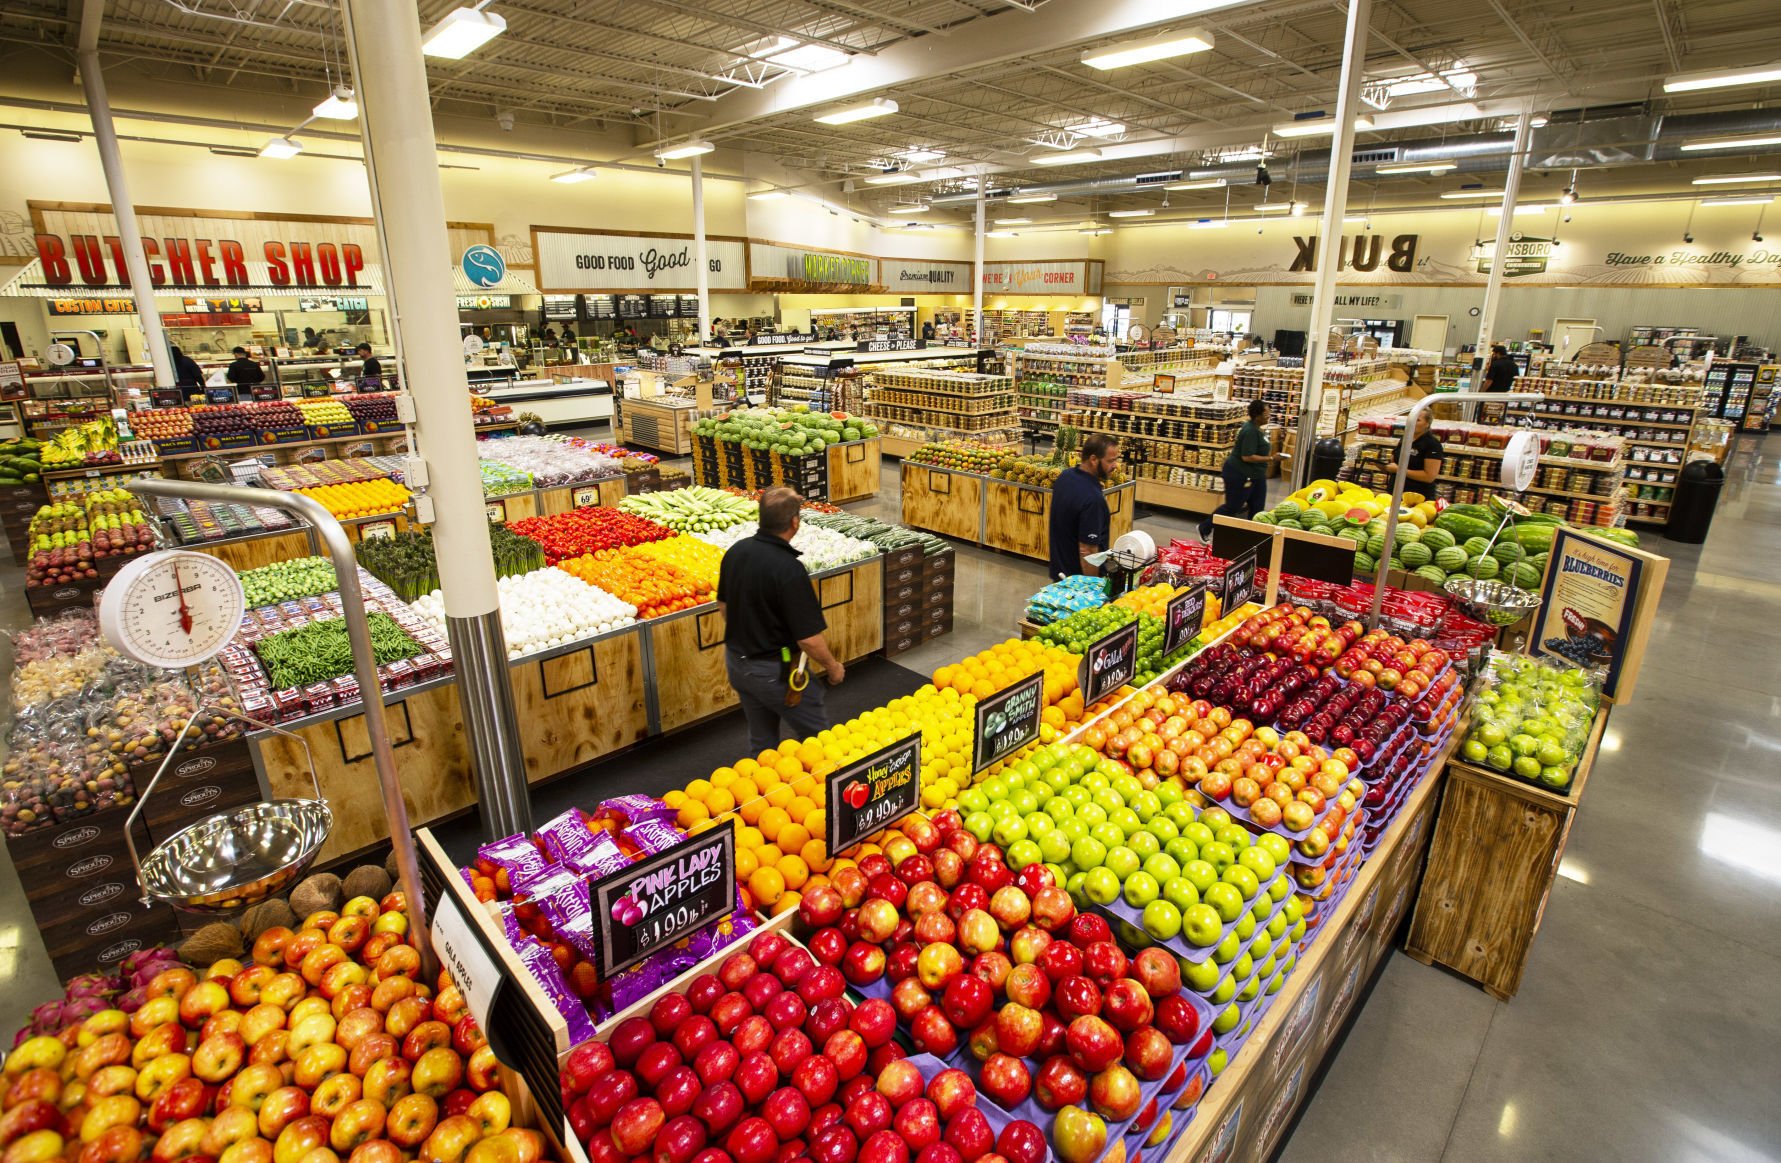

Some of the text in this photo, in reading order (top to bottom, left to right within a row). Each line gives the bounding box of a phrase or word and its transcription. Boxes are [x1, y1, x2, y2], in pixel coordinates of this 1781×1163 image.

[34, 234, 364, 286] BUTCHER SHOP
[576, 246, 722, 280] GOOD FOOD Good GO
[1605, 251, 1652, 267] Have
[1653, 254, 1666, 265] a
[1670, 250, 1745, 268] Healthy
[928, 270, 955, 284] QUALITY
[1043, 272, 1075, 284] CORNER
[54, 298, 134, 313] CUSTOM CUTS
[457, 296, 478, 308] FRESH
[1334, 295, 1380, 307] ALL MY LIFE?
[868, 341, 890, 352] CHEESE
[896, 339, 917, 350] PLEASE
[1562, 555, 1625, 588] BLUEBERRIES
[1004, 683, 1038, 713] GRANNY
[1012, 709, 1034, 725] APPLES
[178, 757, 213, 775] SPROUTS
[871, 763, 912, 802] APPLES
[183, 787, 219, 804] SPROUTS
[56, 828, 97, 847] SPROUTS
[70, 857, 110, 876] SPROUTS
[678, 843, 722, 880] LADY
[628, 864, 678, 904] PINK
[649, 862, 722, 914] APPLES
[82, 885, 121, 904] SPROUTS
[90, 914, 128, 933] SPROUTS
[101, 942, 139, 961] SPROUTS
[445, 941, 457, 964] GALA
[456, 960, 473, 992] APPLES
